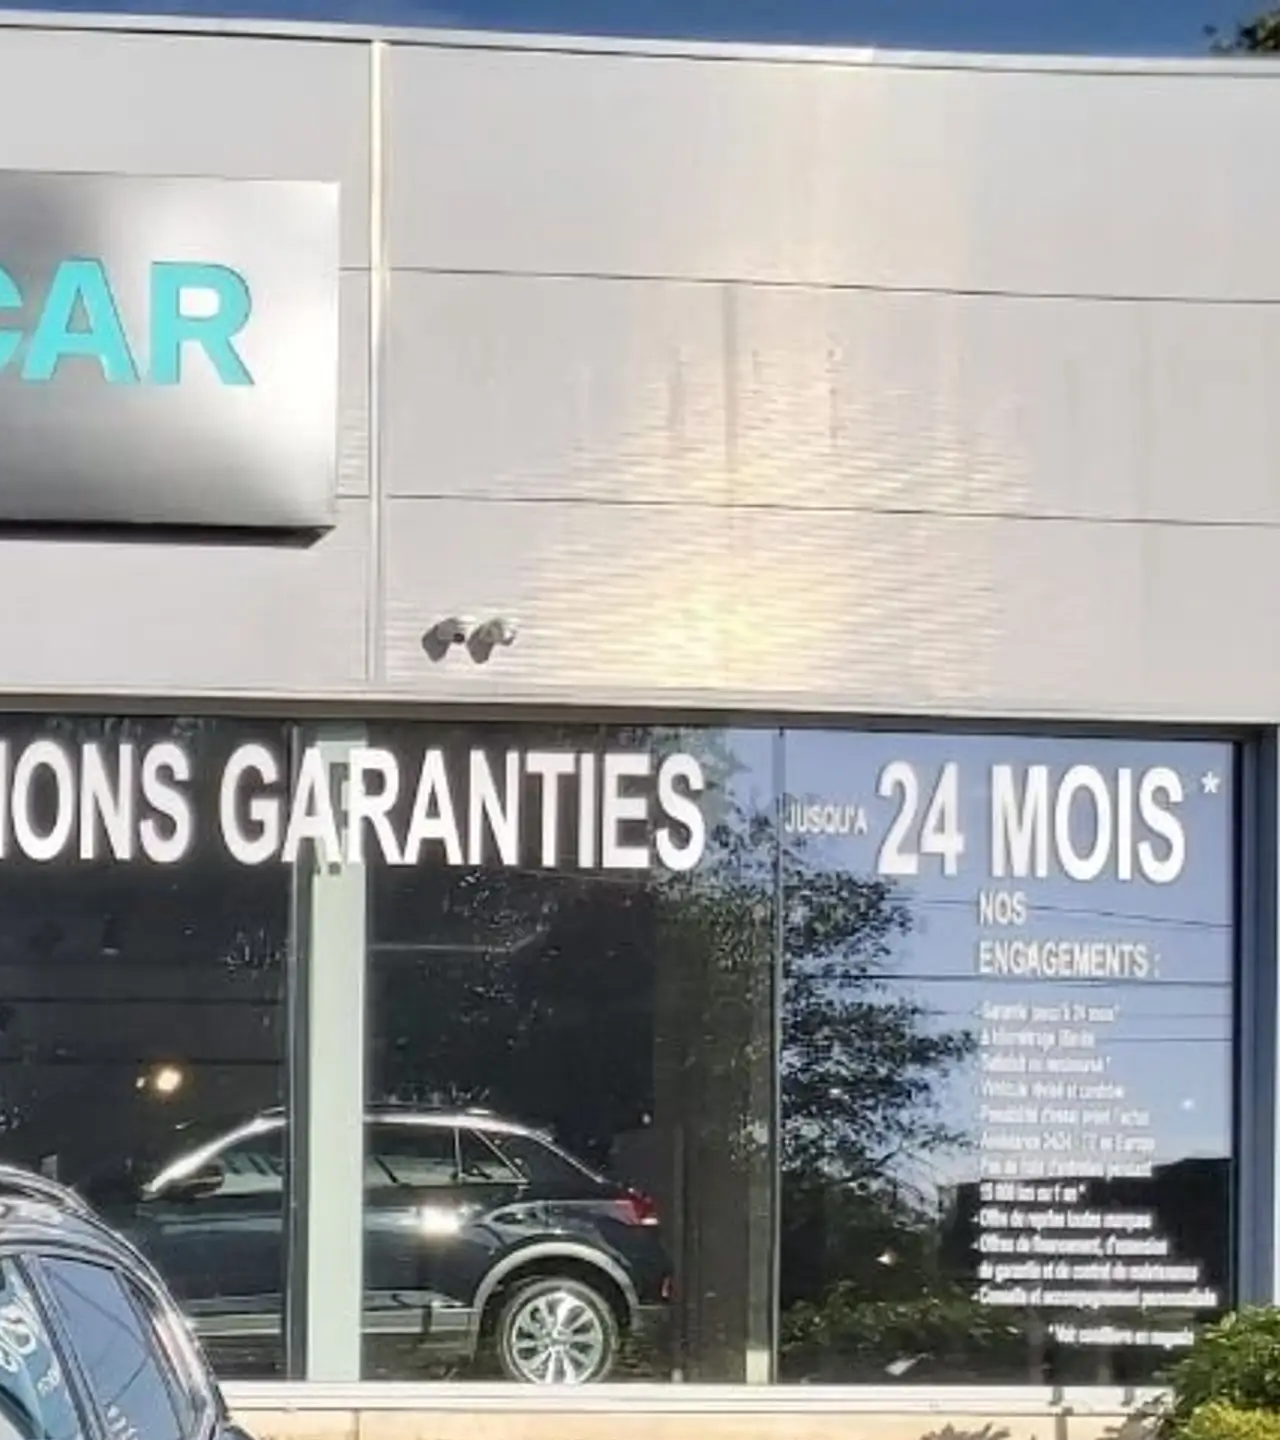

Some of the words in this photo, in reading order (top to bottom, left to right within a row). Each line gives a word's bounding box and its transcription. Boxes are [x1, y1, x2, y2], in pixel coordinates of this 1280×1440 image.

[218, 743, 705, 871] GARANTIES
[876, 761, 965, 876] 24
[990, 763, 1187, 883] MOIS
[979, 890, 1028, 926] NOS
[979, 940, 1149, 978] ENGAGEMENTS
